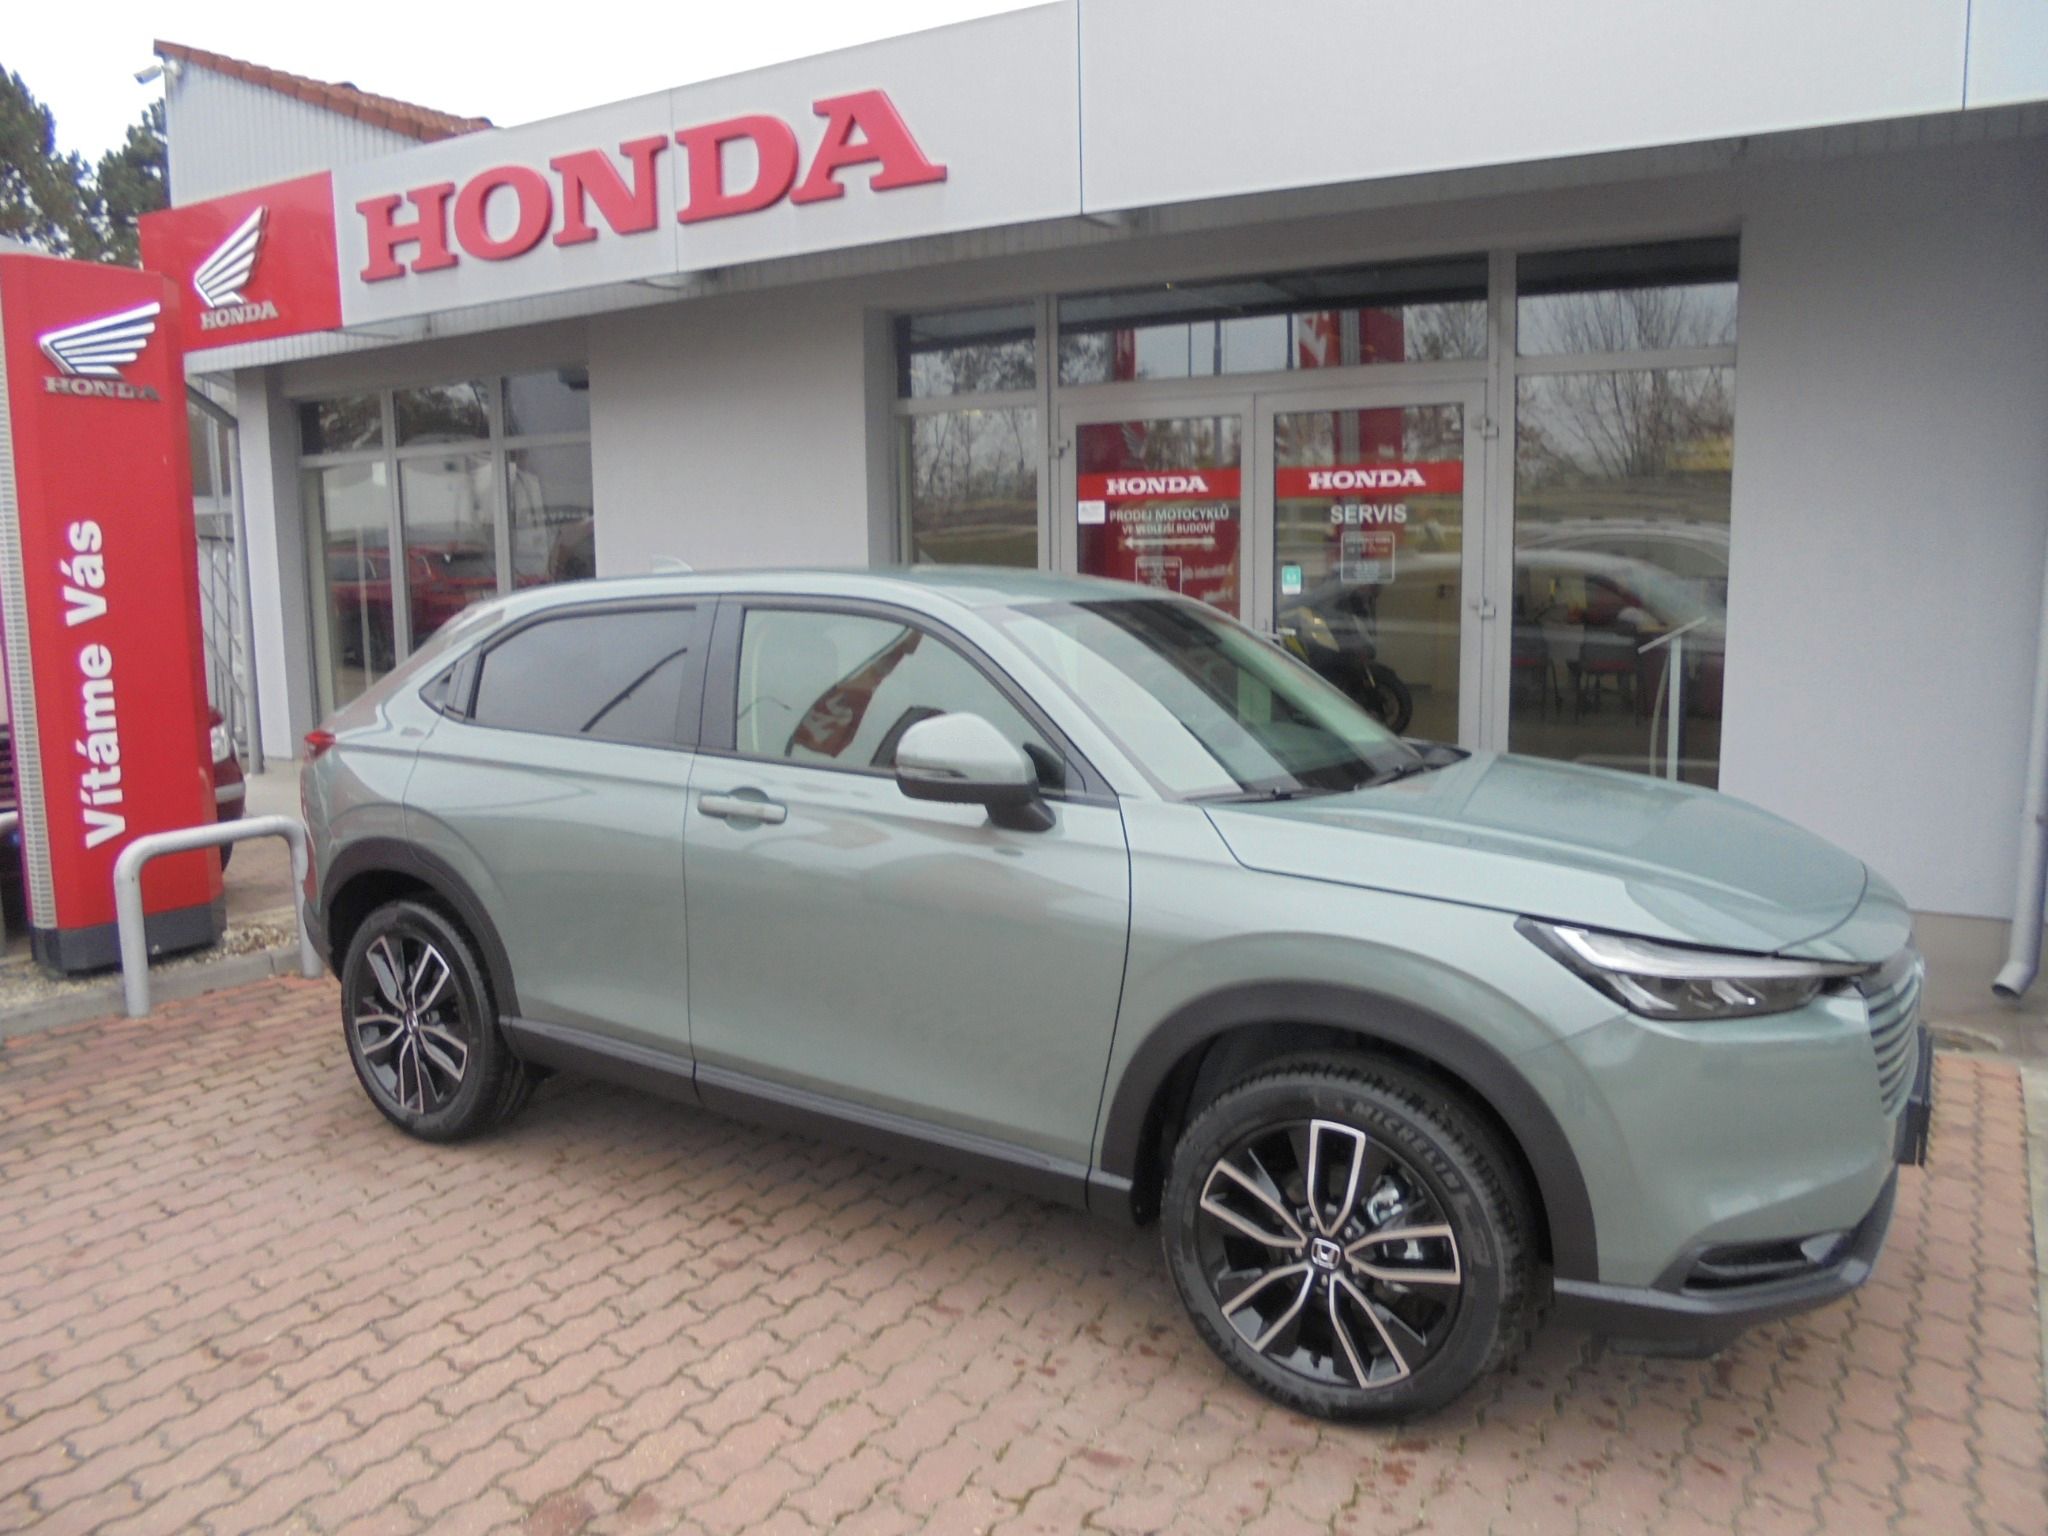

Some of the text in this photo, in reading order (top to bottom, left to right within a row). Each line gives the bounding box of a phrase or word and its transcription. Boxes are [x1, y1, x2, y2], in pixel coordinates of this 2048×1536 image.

[356, 88, 947, 283] HONDA
[200, 300, 279, 330] HONDA
[43, 376, 160, 401] HONDA
[1106, 475, 1209, 496] HONDA
[1308, 468, 1426, 490] HONDA
[1109, 508, 1152, 523] PRODEJ
[1155, 503, 1230, 521] MOTOCYKLŮ
[1330, 503, 1408, 524] SERVIS
[60, 519, 126, 849] Vítáme Vás
